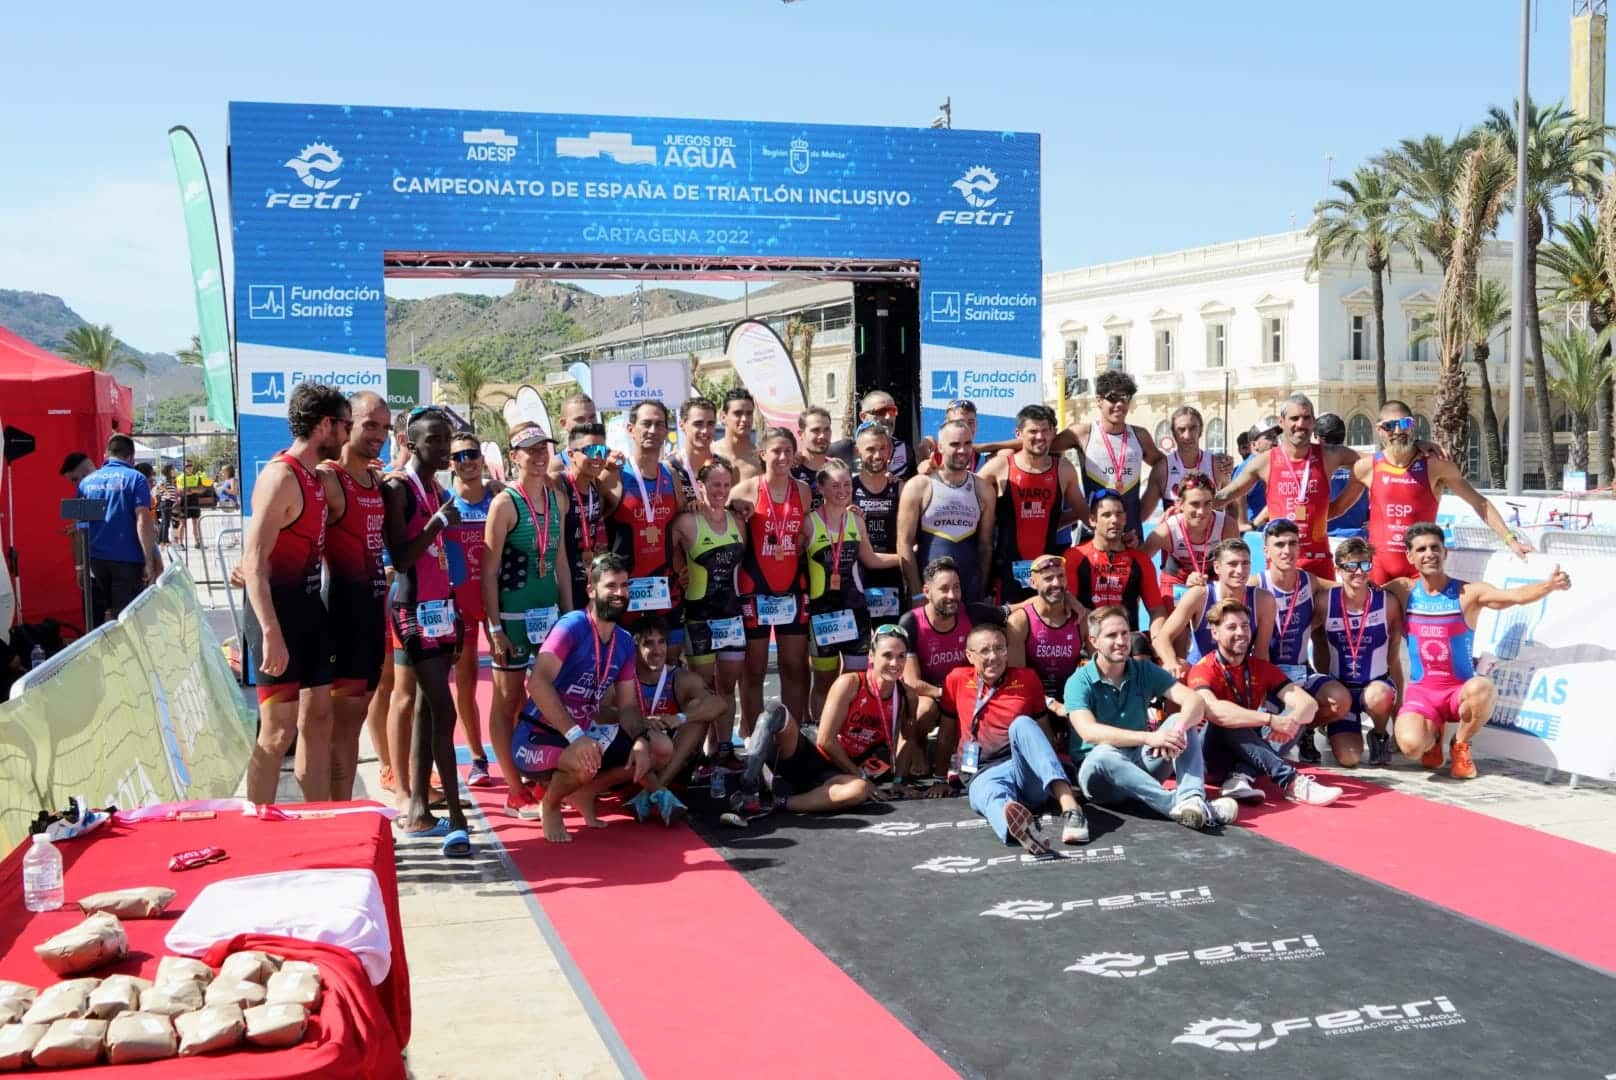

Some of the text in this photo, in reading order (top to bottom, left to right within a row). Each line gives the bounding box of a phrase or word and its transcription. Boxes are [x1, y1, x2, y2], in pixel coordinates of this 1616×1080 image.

[663, 135, 736, 148] JUEGOS DEL
[466, 145, 517, 162] ADESP
[664, 147, 736, 169] AGUA
[392, 176, 911, 206] CAMPEONATO DE ESPAÑA DE TRIATLÓN INCLUSIVO
[582, 226, 749, 244] CARTAGENA 2022
[291, 285, 380, 301] Fundación
[964, 292, 1037, 307] Fundación
[290, 303, 353, 317] Sanitas
[964, 308, 1016, 322] Sanitas
[963, 370, 1037, 384] Fundación
[963, 387, 1016, 399] Sanitas
[1386, 504, 1413, 517] ESP
[1036, 645, 1073, 658] ESCABIAS
[1491, 713, 1545, 733] DEPORTE
[516, 745, 544, 763] PINA
[1324, 1019, 1398, 1036] FEDERACIÓN
